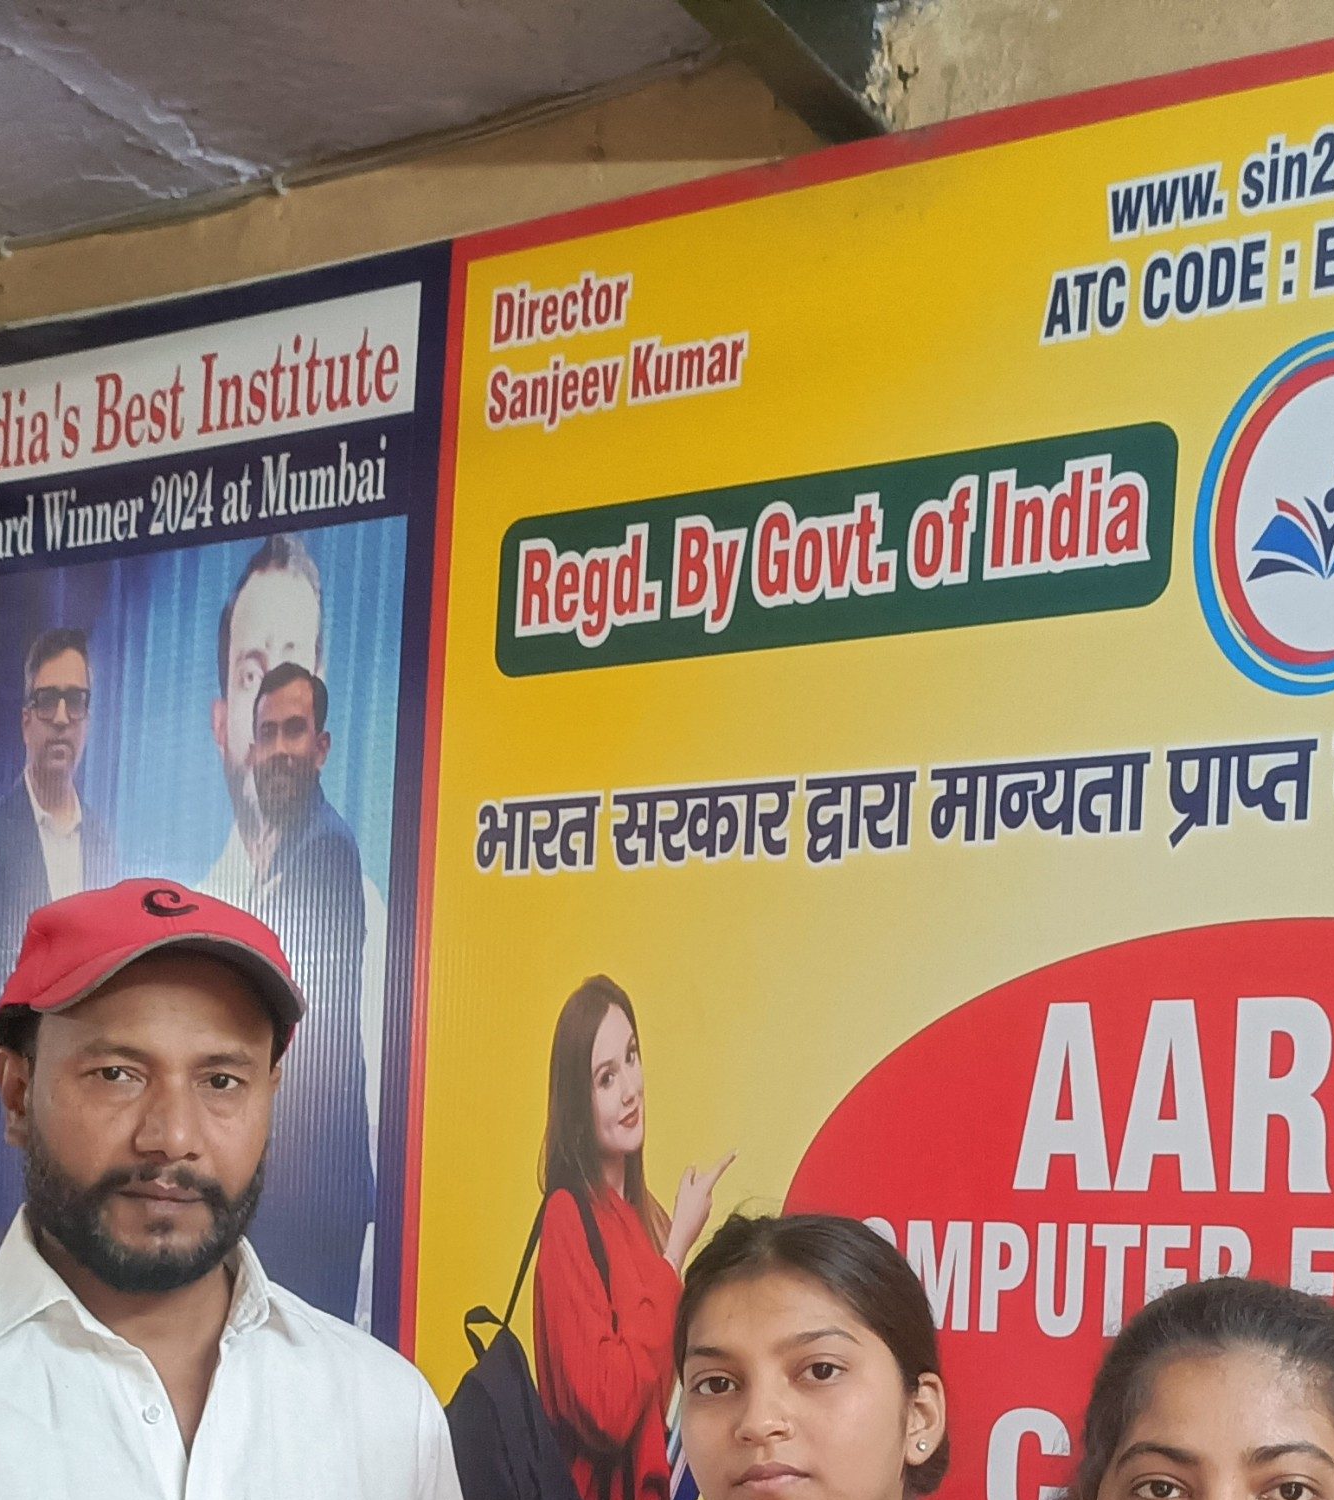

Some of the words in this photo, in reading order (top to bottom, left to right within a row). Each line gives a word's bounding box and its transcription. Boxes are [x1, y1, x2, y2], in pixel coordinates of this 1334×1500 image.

[1111, 170, 1223, 234] www.
[492, 277, 629, 342] Director
[1044, 268, 1126, 338] ATC
[1143, 240, 1267, 320] CODE
[92, 366, 186, 453] Best
[198, 328, 400, 434] Institute
[489, 357, 620, 426] Sanjeev
[631, 336, 745, 396] Kumar
[43, 488, 144, 550] Winner
[151, 466, 213, 536] 2024
[222, 463, 252, 525] at
[259, 434, 387, 518] Mumbai
[518, 530, 657, 638] Regd.
[676, 524, 740, 623] By
[758, 502, 893, 600] Govt.
[913, 484, 973, 580] of
[990, 466, 1140, 568] India
[477, 797, 602, 870] भारत
[613, 782, 796, 868] सरकार
[805, 770, 917, 862] द्वारा
[931, 752, 1151, 845] मान्यता
[1167, 738, 1319, 848] प्राप्त
[862, 1217, 1253, 1340] MPUTE
